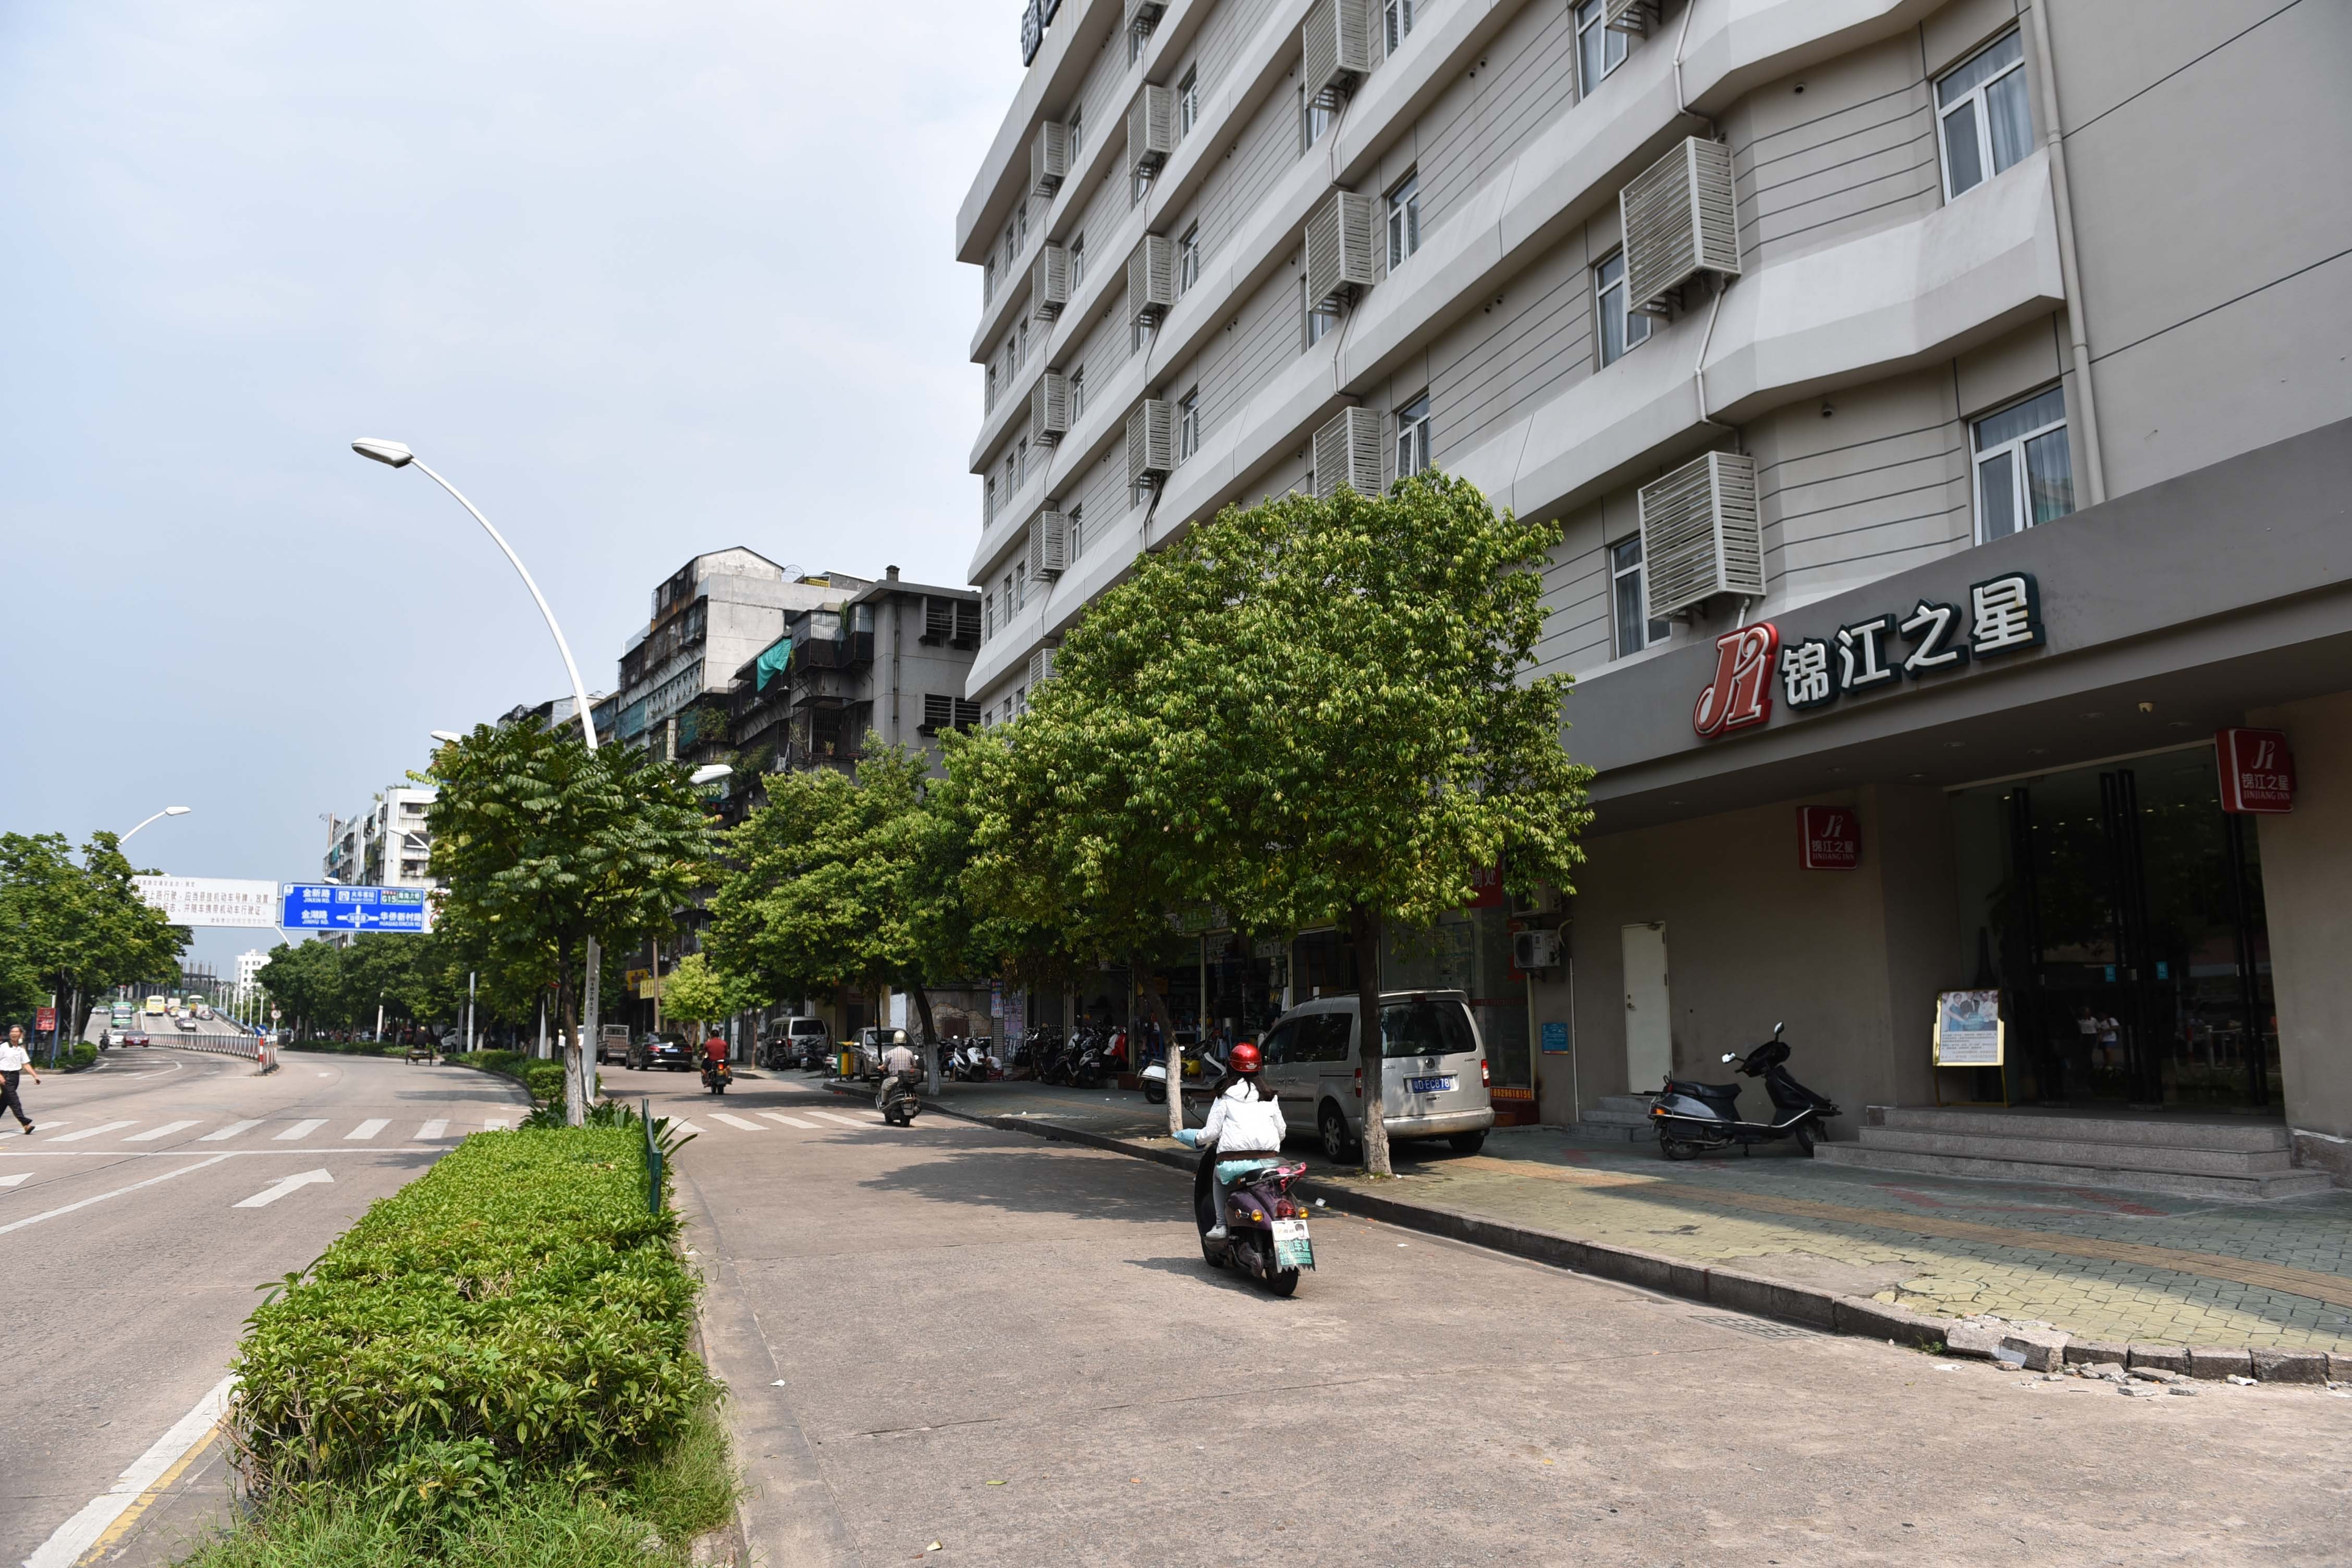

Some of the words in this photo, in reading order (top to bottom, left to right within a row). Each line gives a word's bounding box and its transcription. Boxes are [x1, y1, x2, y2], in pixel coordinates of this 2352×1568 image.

[1780, 574, 2040, 707] 锦江之星
[2241, 773, 2290, 790] 锦江之星
[1811, 839, 1855, 853] 锦江之星
[302, 888, 330, 898] 金新路
[301, 909, 328, 919] 金湖路
[379, 911, 422, 922] 华侨新村路
